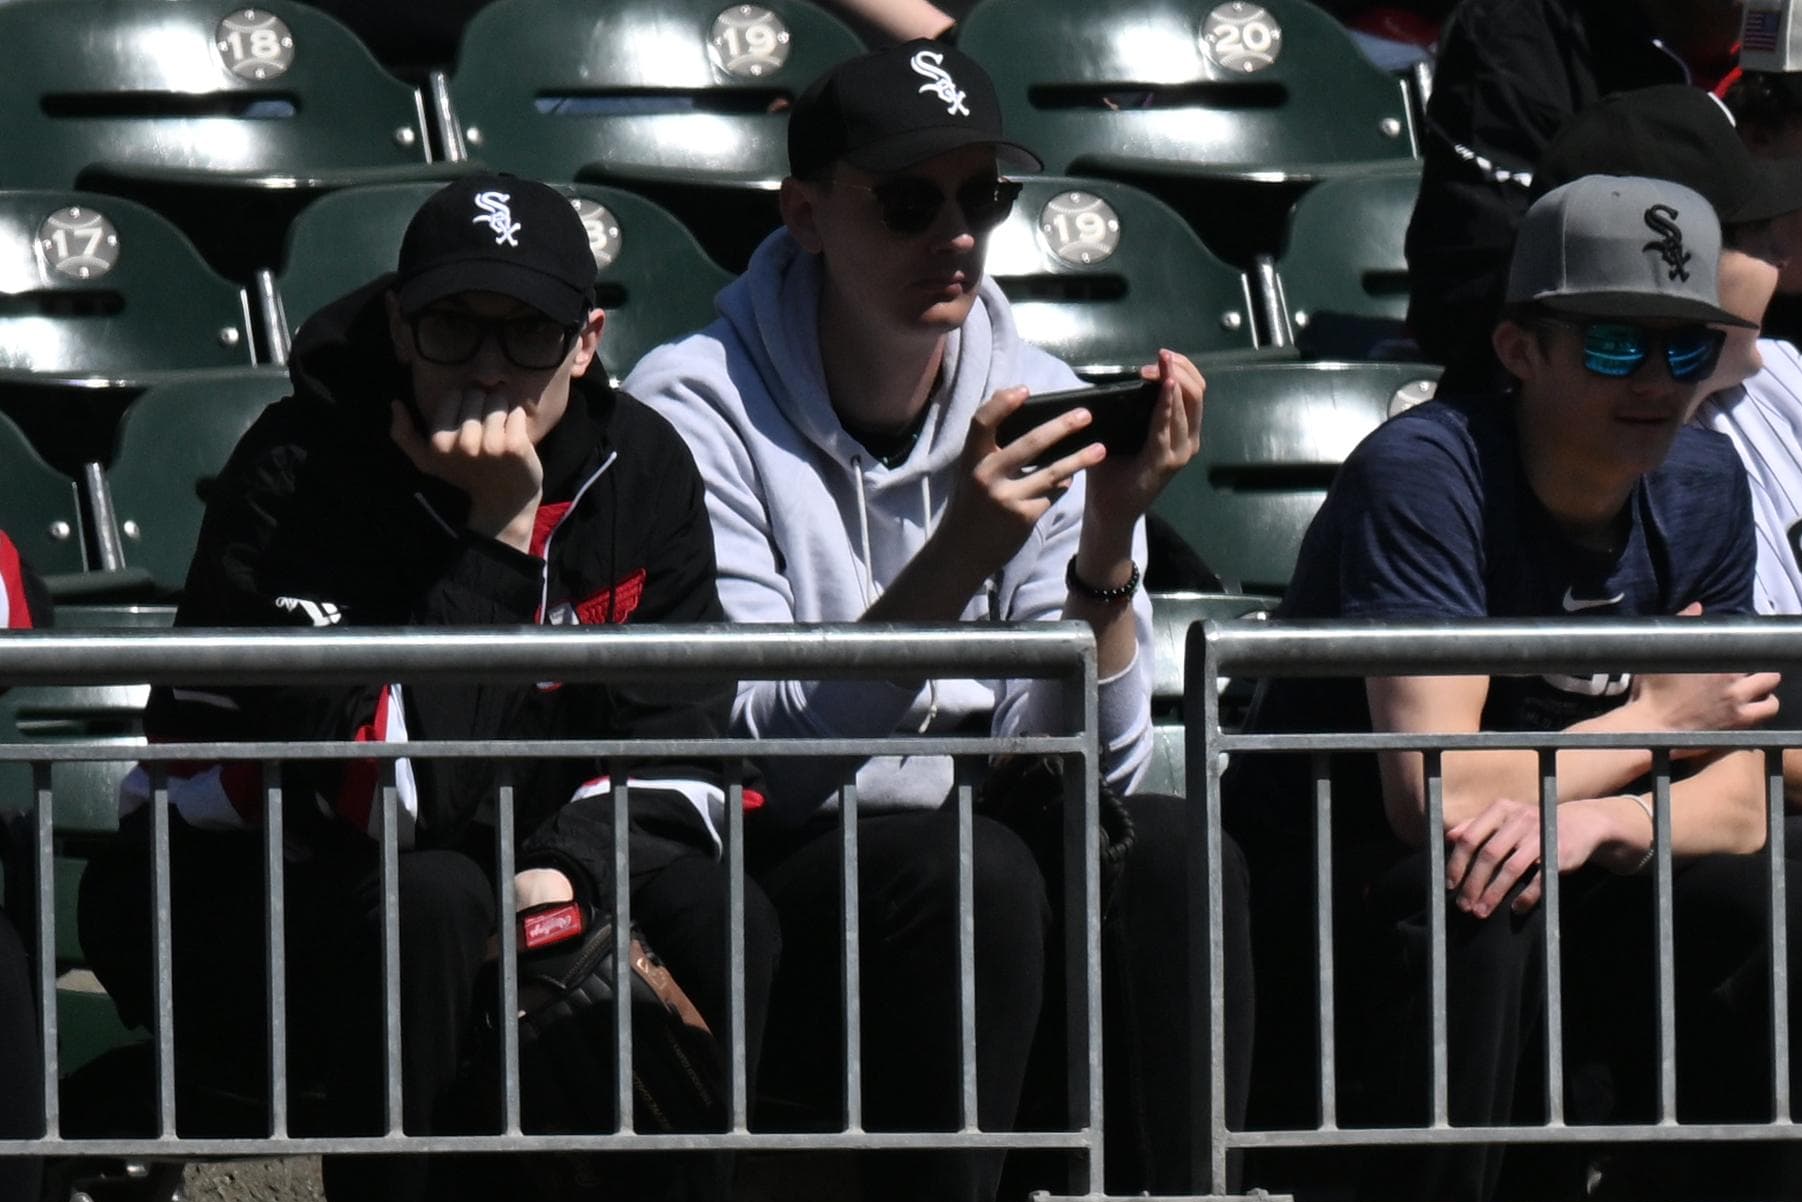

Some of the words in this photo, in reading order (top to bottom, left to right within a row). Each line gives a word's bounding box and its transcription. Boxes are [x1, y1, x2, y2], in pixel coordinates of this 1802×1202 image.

[229, 29, 280, 58] 18
[723, 26, 775, 56] 19
[1212, 22, 1271, 50] 20
[911, 50, 970, 117] Sox
[472, 191, 521, 248] Sox
[1053, 213, 1106, 241] 19
[52, 227, 103, 256] 17
[1643, 204, 1691, 282] Sox
